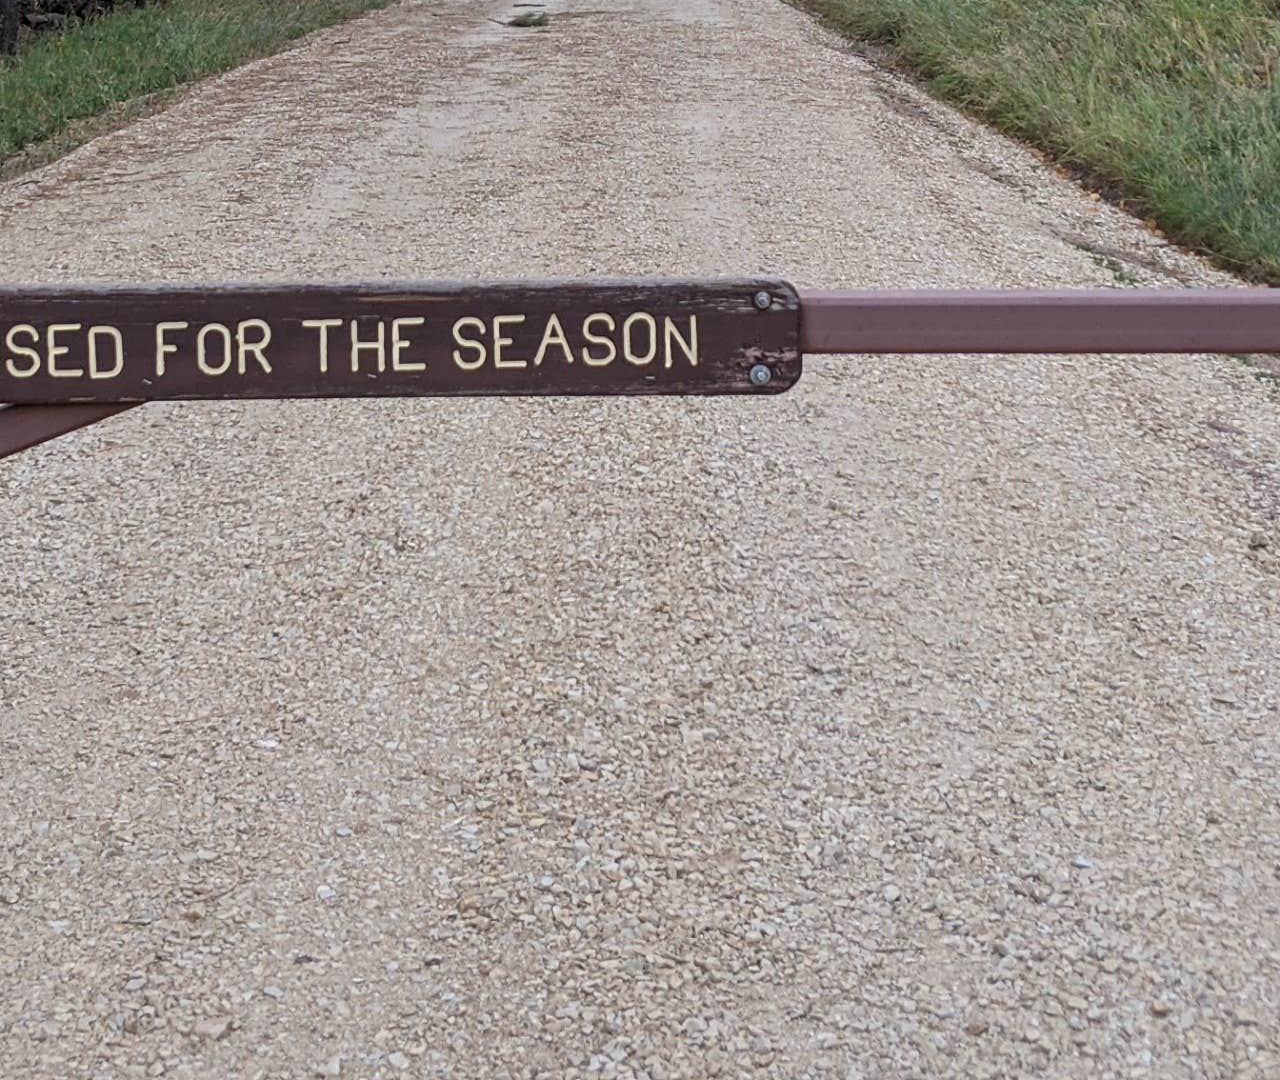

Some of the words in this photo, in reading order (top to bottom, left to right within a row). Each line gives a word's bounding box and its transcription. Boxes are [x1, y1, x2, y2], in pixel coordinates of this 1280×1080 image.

[155, 319, 273, 377] FOR
[301, 317, 427, 373] THE
[452, 312, 699, 370] SEASON
